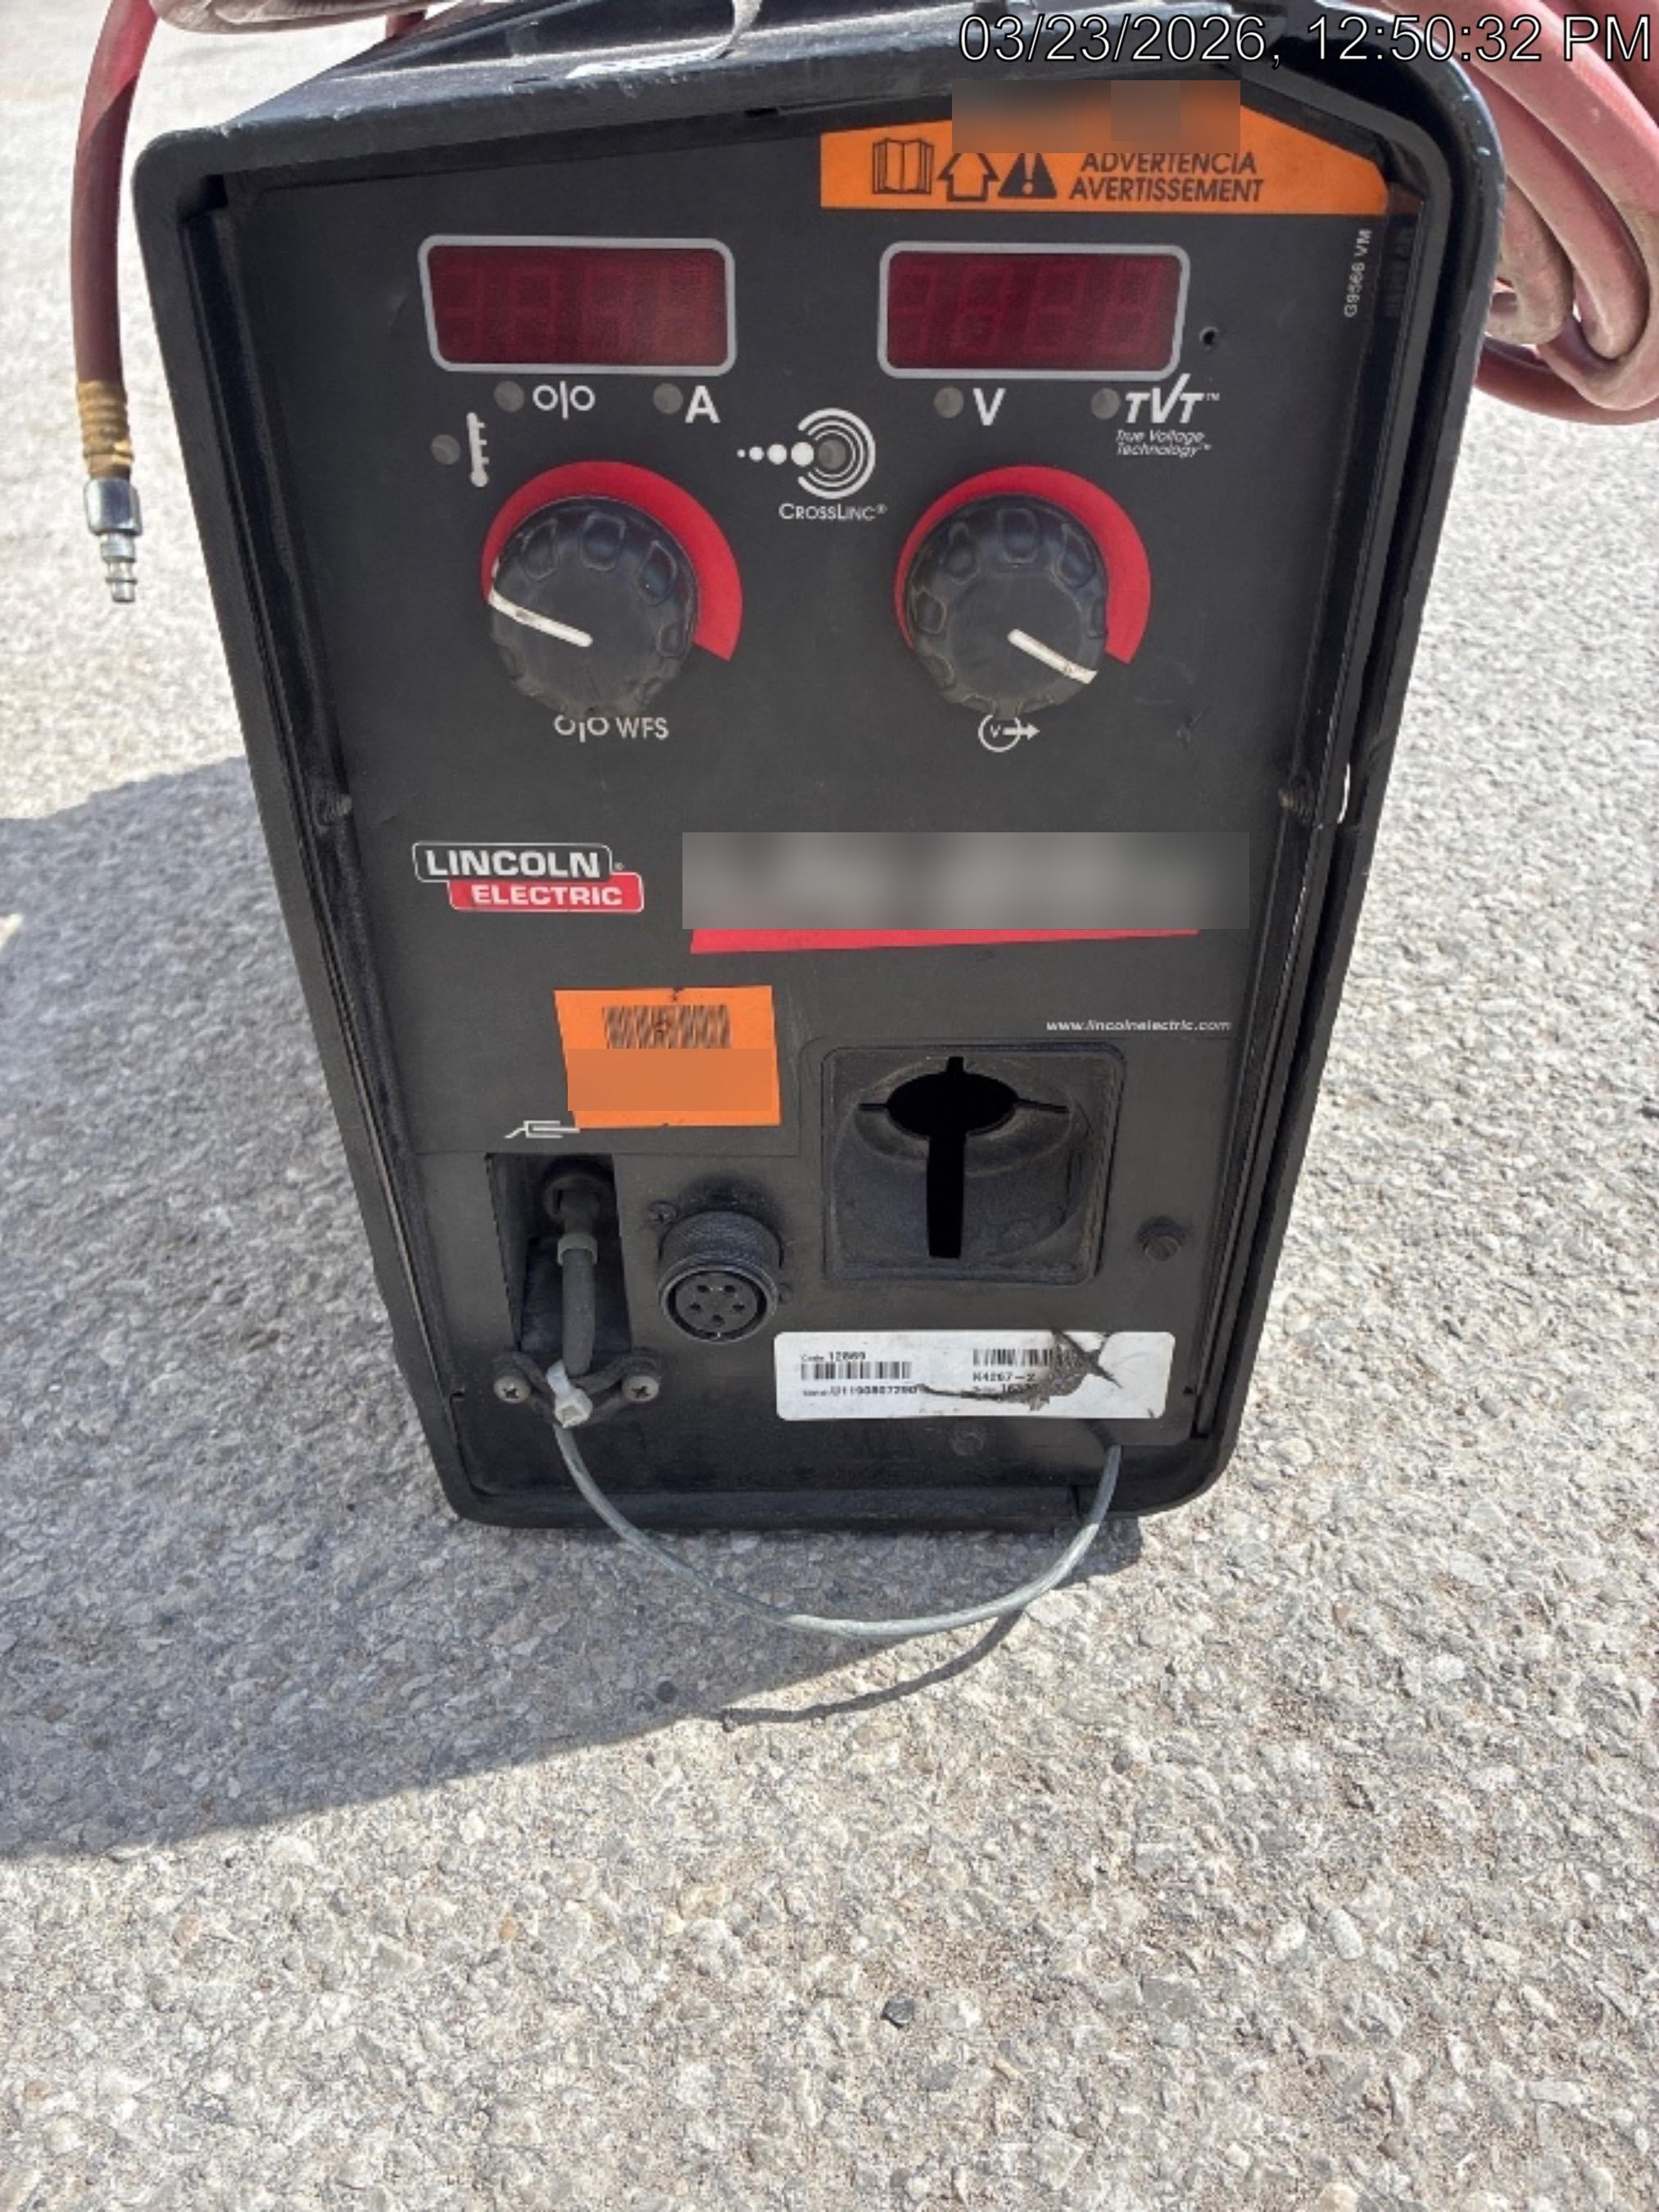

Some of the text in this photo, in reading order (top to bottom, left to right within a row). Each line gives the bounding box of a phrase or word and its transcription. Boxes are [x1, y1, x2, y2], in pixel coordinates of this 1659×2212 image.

[1081, 152, 1258, 175] ADVERTENCIA
[1068, 175, 1265, 202] AVERTISSEMENT
[685, 385, 720, 424] A
[972, 388, 1006, 426] V
[1117, 429, 1205, 446] True Voltage
[615, 716, 669, 741] WFS
[424, 849, 601, 879] LINCOLN
[470, 884, 623, 906] ELECTRIC
[1046, 1019, 1232, 1031] www.lincolnelectric.com
